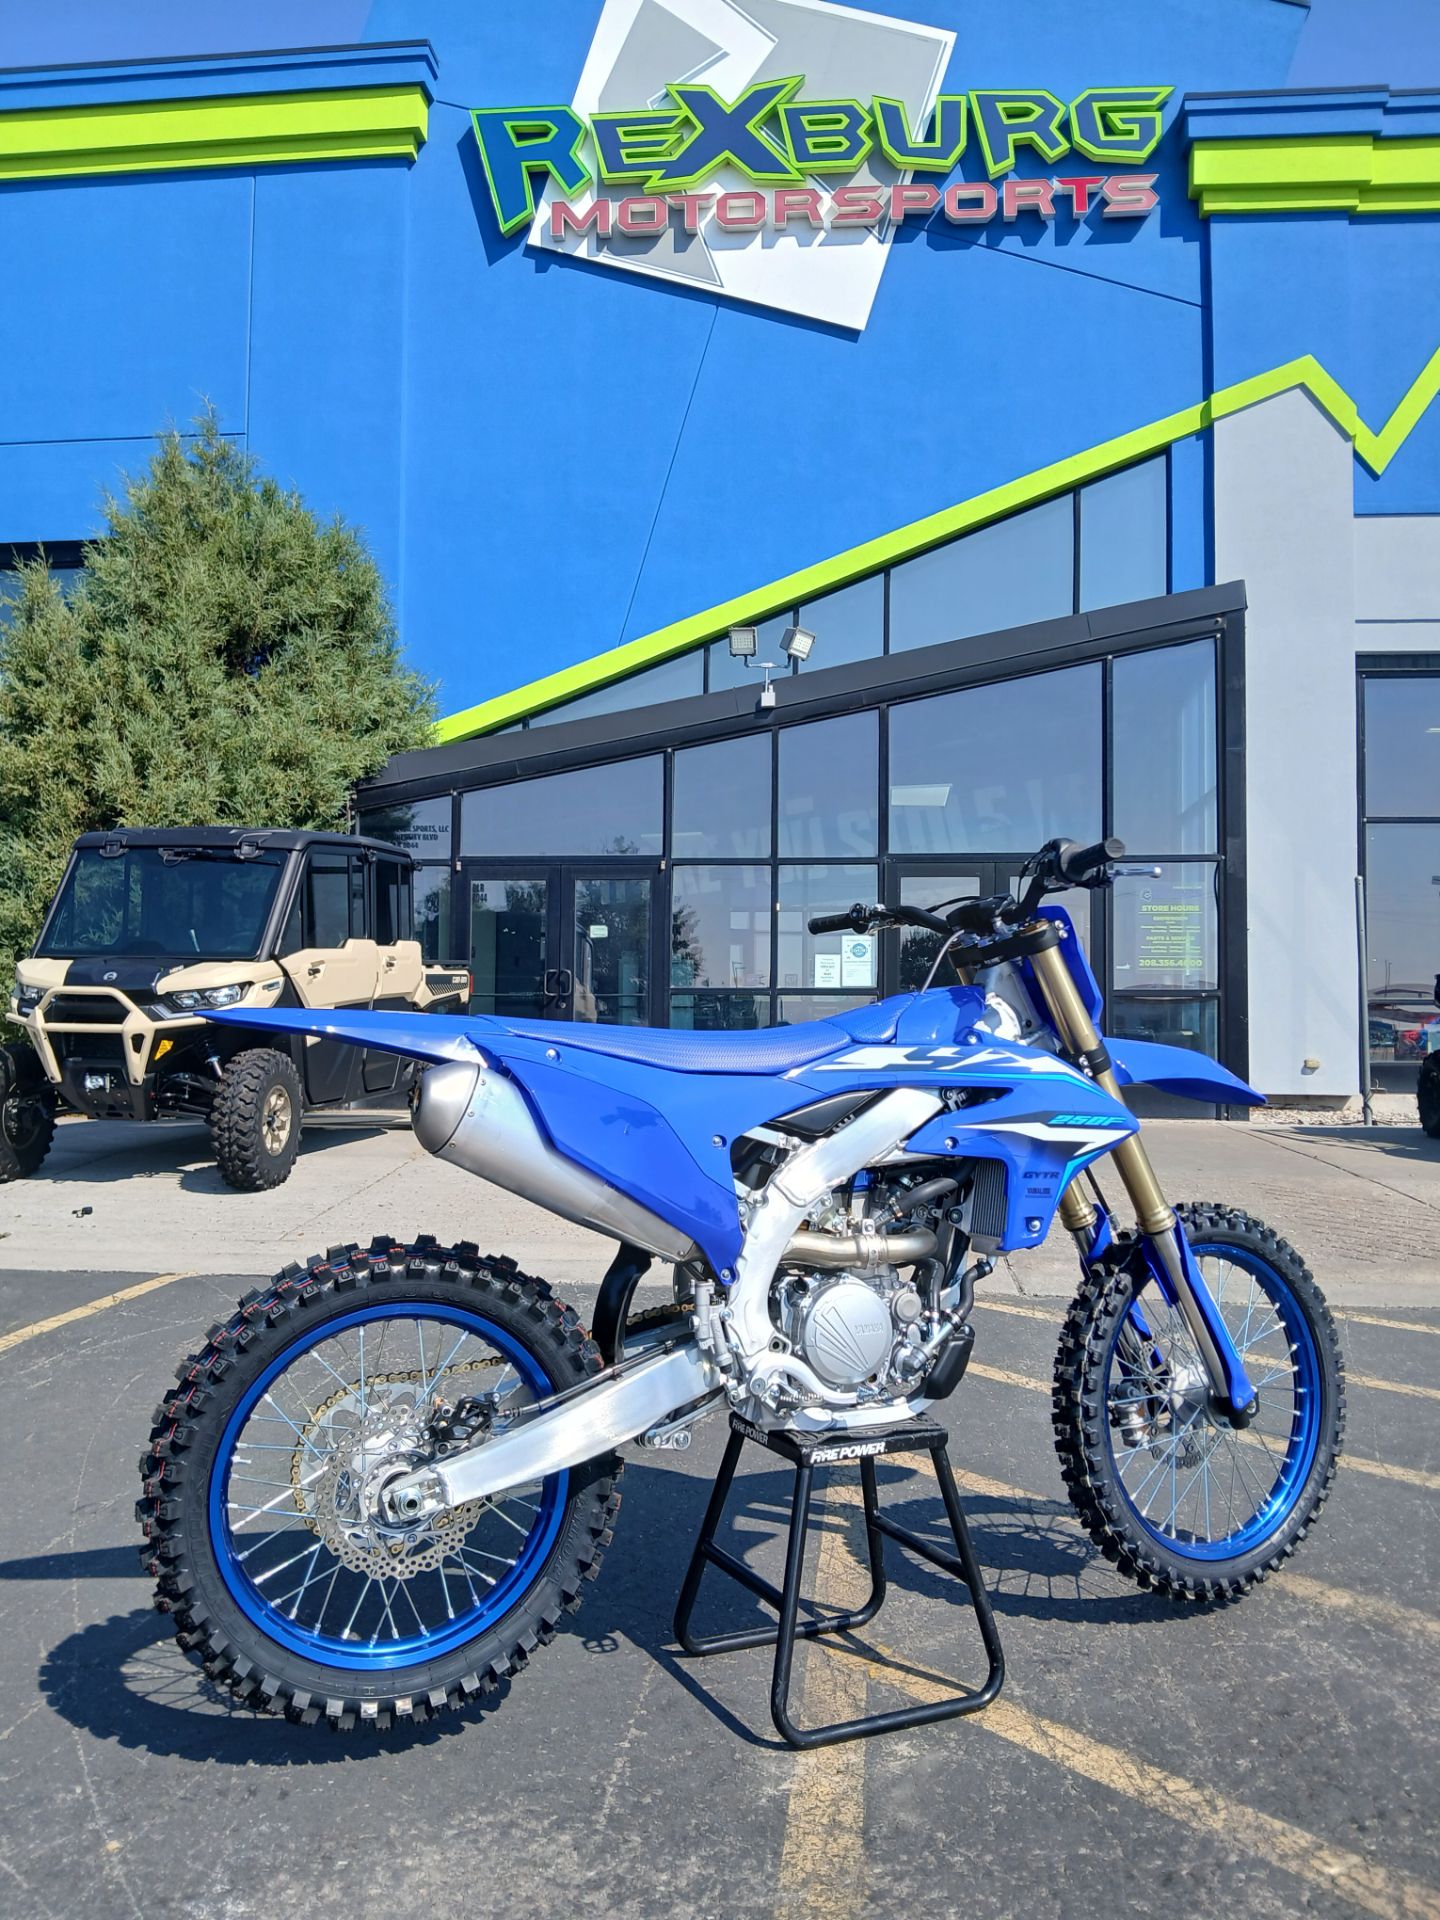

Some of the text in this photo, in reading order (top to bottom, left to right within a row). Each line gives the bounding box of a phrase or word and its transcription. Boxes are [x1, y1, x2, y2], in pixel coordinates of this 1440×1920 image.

[471, 74, 1175, 237] REXBURG
[549, 174, 1160, 241] MOTORSPORTS
[438, 825, 449, 833] LLC
[1141, 904, 1200, 912] STORE HOURS
[1047, 1114, 1128, 1127] 250F
[1022, 1170, 1061, 1180] GYTR
[747, 1424, 769, 1446] POWER
[810, 1441, 886, 1464] FIRE POWER
